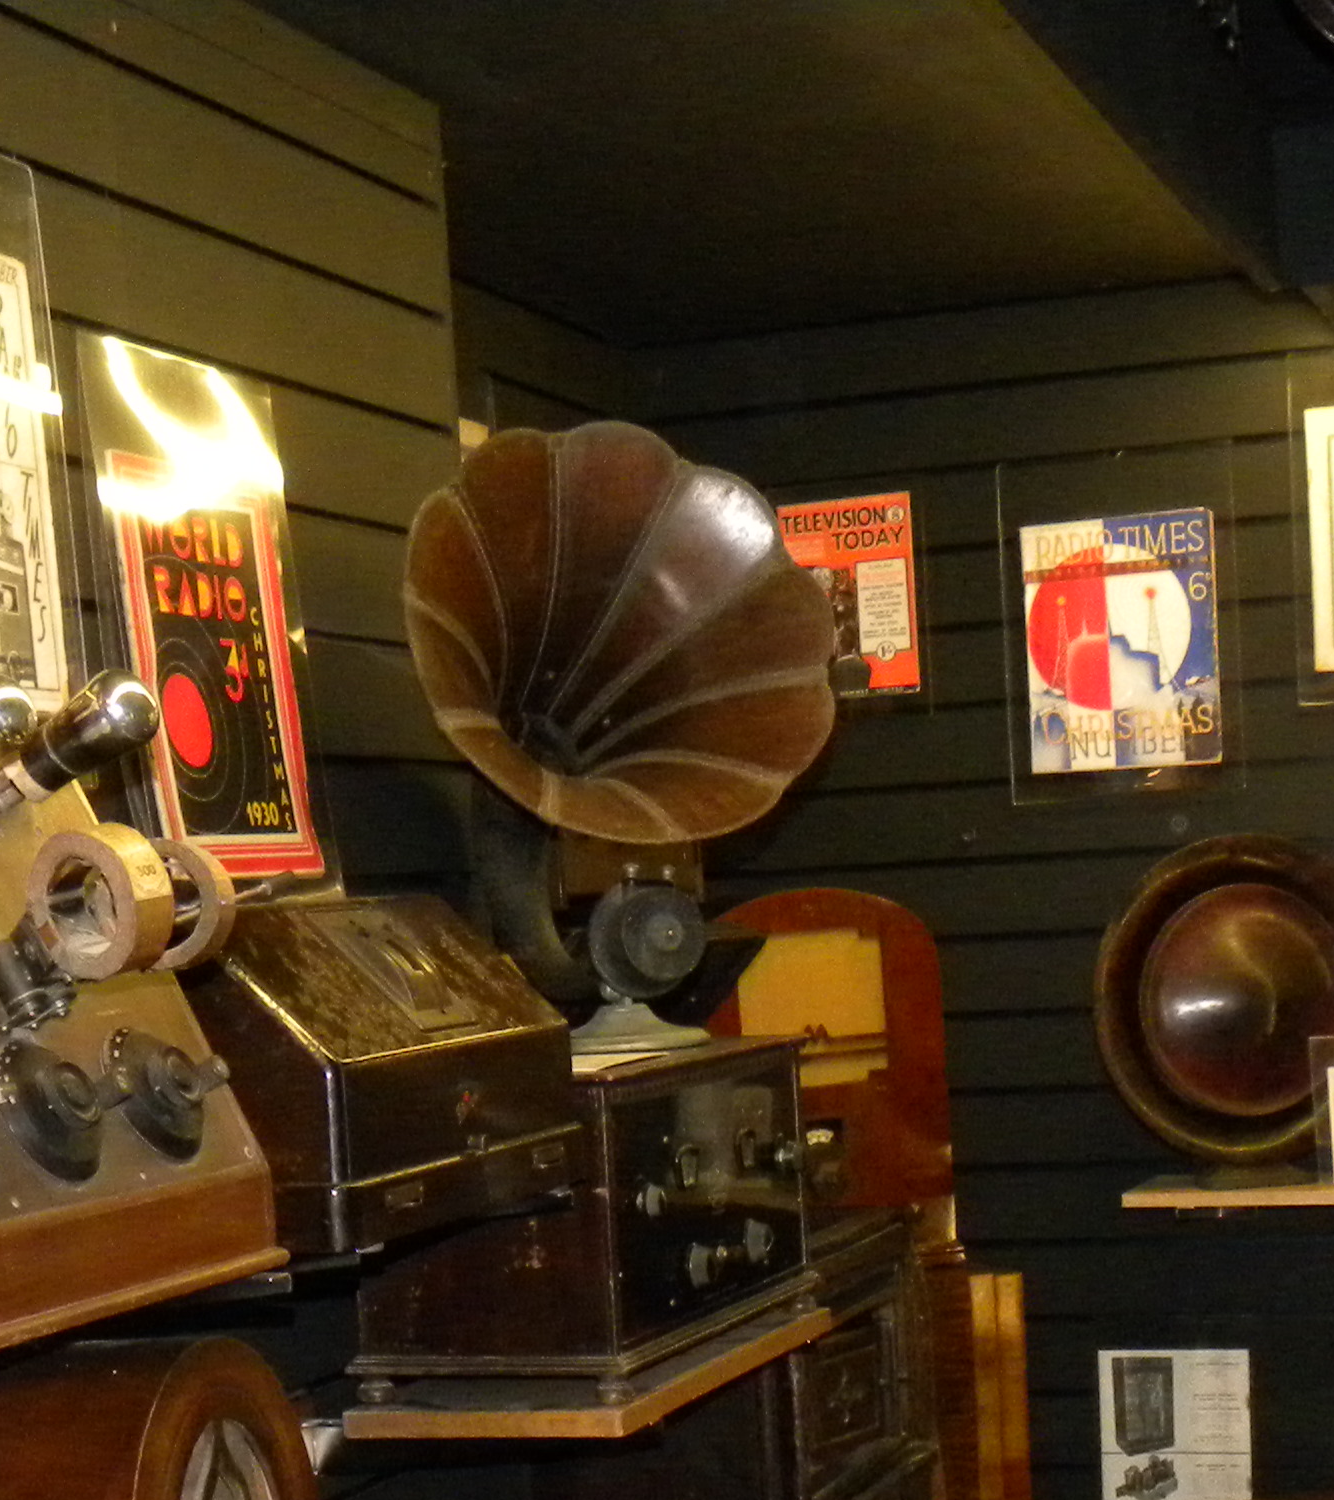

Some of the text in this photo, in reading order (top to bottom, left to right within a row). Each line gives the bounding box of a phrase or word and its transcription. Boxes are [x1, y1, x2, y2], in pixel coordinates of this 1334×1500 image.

[142, 517, 244, 568] WORLD
[782, 506, 886, 534] TELEVISION
[832, 525, 904, 551] TODAY
[1035, 530, 1112, 568] RADIO
[1119, 520, 1205, 558] TIMES
[21, 471, 47, 643] TIMES
[153, 566, 246, 622] RADIO
[250, 606, 293, 833] CHRISTMAS
[246, 801, 279, 827] 1930
